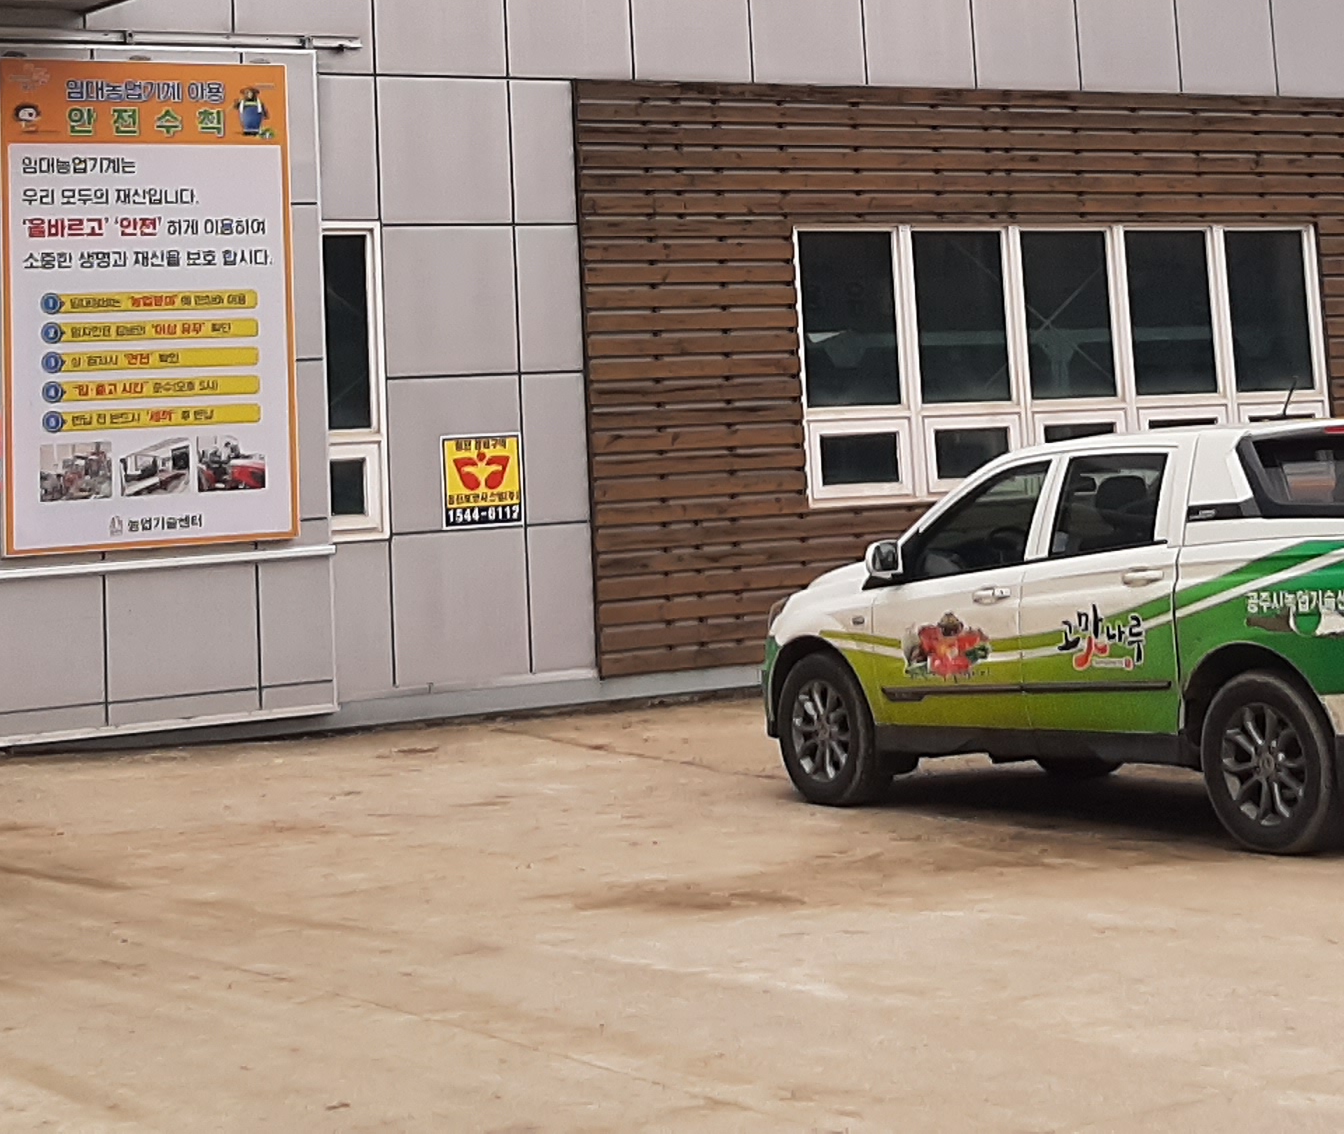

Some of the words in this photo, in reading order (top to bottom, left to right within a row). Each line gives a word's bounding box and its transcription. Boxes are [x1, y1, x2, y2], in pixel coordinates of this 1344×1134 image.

[65, 78, 182, 103] 임대농업기계
[22, 156, 137, 175] 임대농업기계는
[22, 188, 55, 206] 우리
[61, 188, 109, 206] 모두의
[115, 187, 199, 206] 재산입니다.
[167, 219, 199, 236] 하게
[204, 219, 266, 236] 이용하여
[23, 251, 73, 270] 소중한
[78, 250, 127, 269] 생명과
[186, 251, 217, 266] 보호
[222, 249, 274, 266] 합시다.
[127, 513, 203, 533] 농업기술센터
